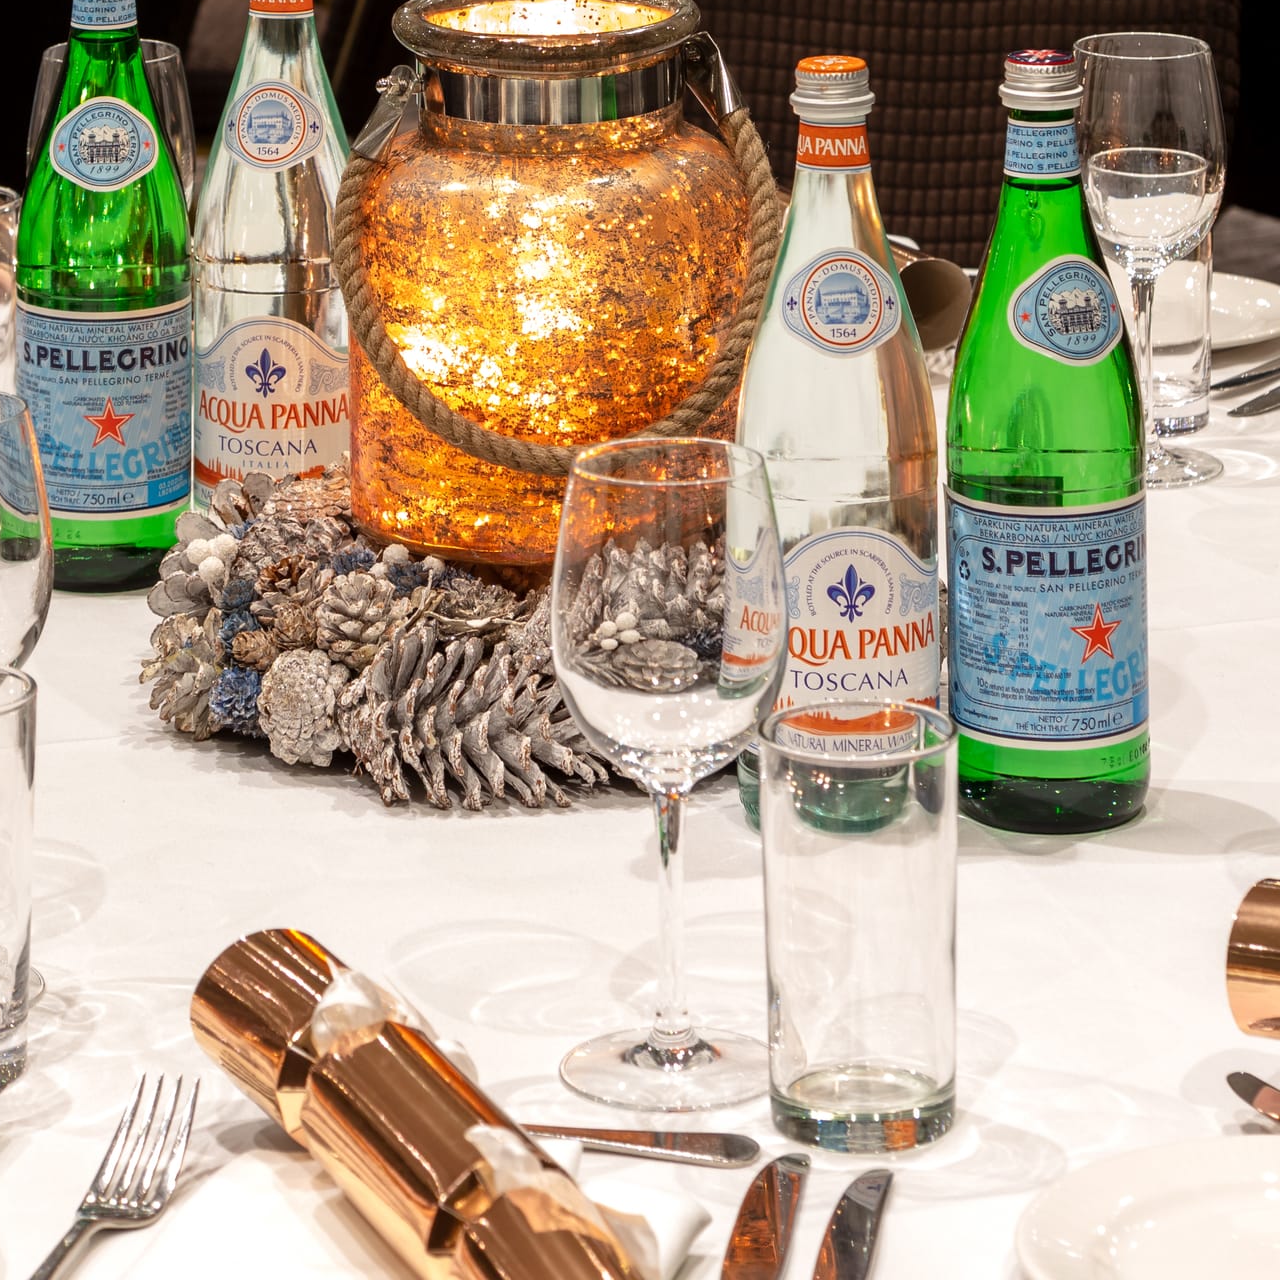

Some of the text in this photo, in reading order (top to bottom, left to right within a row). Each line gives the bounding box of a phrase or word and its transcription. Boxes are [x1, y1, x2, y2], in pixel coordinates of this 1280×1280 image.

[241, 92, 301, 140] PANNA DOMUS MEDICIS
[72, 111, 137, 166] SAN PELLEGRINO TERME
[815, 135, 867, 157] PANNA
[257, 146, 280, 156] 1564
[90, 165, 120, 174] 1899
[806, 263, 878, 320] PANNA DOMUS MEDICIS
[1039, 271, 1097, 307] PELLEGRINO
[48, 323, 84, 334] NATURAL
[87, 324, 125, 334] MINERAL
[128, 321, 154, 332] WATER
[831, 328, 856, 338] 1564
[1040, 313, 1057, 337] SAN
[1066, 333, 1097, 346] 1899
[23, 335, 189, 373] S.PELLEGRINO
[58, 374, 78, 384] SAN
[82, 373, 141, 386] PELLEGRINO
[145, 371, 169, 382] TERME
[198, 390, 266, 433] ACQUA
[271, 392, 350, 430] PANNA
[218, 435, 318, 457] TOSCANA
[242, 460, 290, 469] ITALIA
[82, 493, 105, 505] 750
[107, 492, 120, 504] ml
[974, 517, 1021, 532] SPARKLING
[1024, 521, 1069, 532] NATURAL
[1073, 517, 1111, 532] MINERAL
[1114, 512, 1135, 525] WATER
[979, 528, 1050, 543] BERKARBONASI
[806, 583, 817, 617] BOTTLED
[812, 564, 822, 577] THE
[821, 548, 848, 565] SOURCE
[1040, 583, 1064, 593] SAN
[1069, 576, 1126, 592] PELLEGRINO
[858, 611, 935, 660] PANNA
[790, 668, 909, 692] TOSCANA
[976, 677, 988, 688] 10c
[1038, 715, 1062, 723] NETTO
[1071, 716, 1096, 731] 750
[1098, 713, 1110, 729] ml
[832, 738, 884, 753] MINERAL
